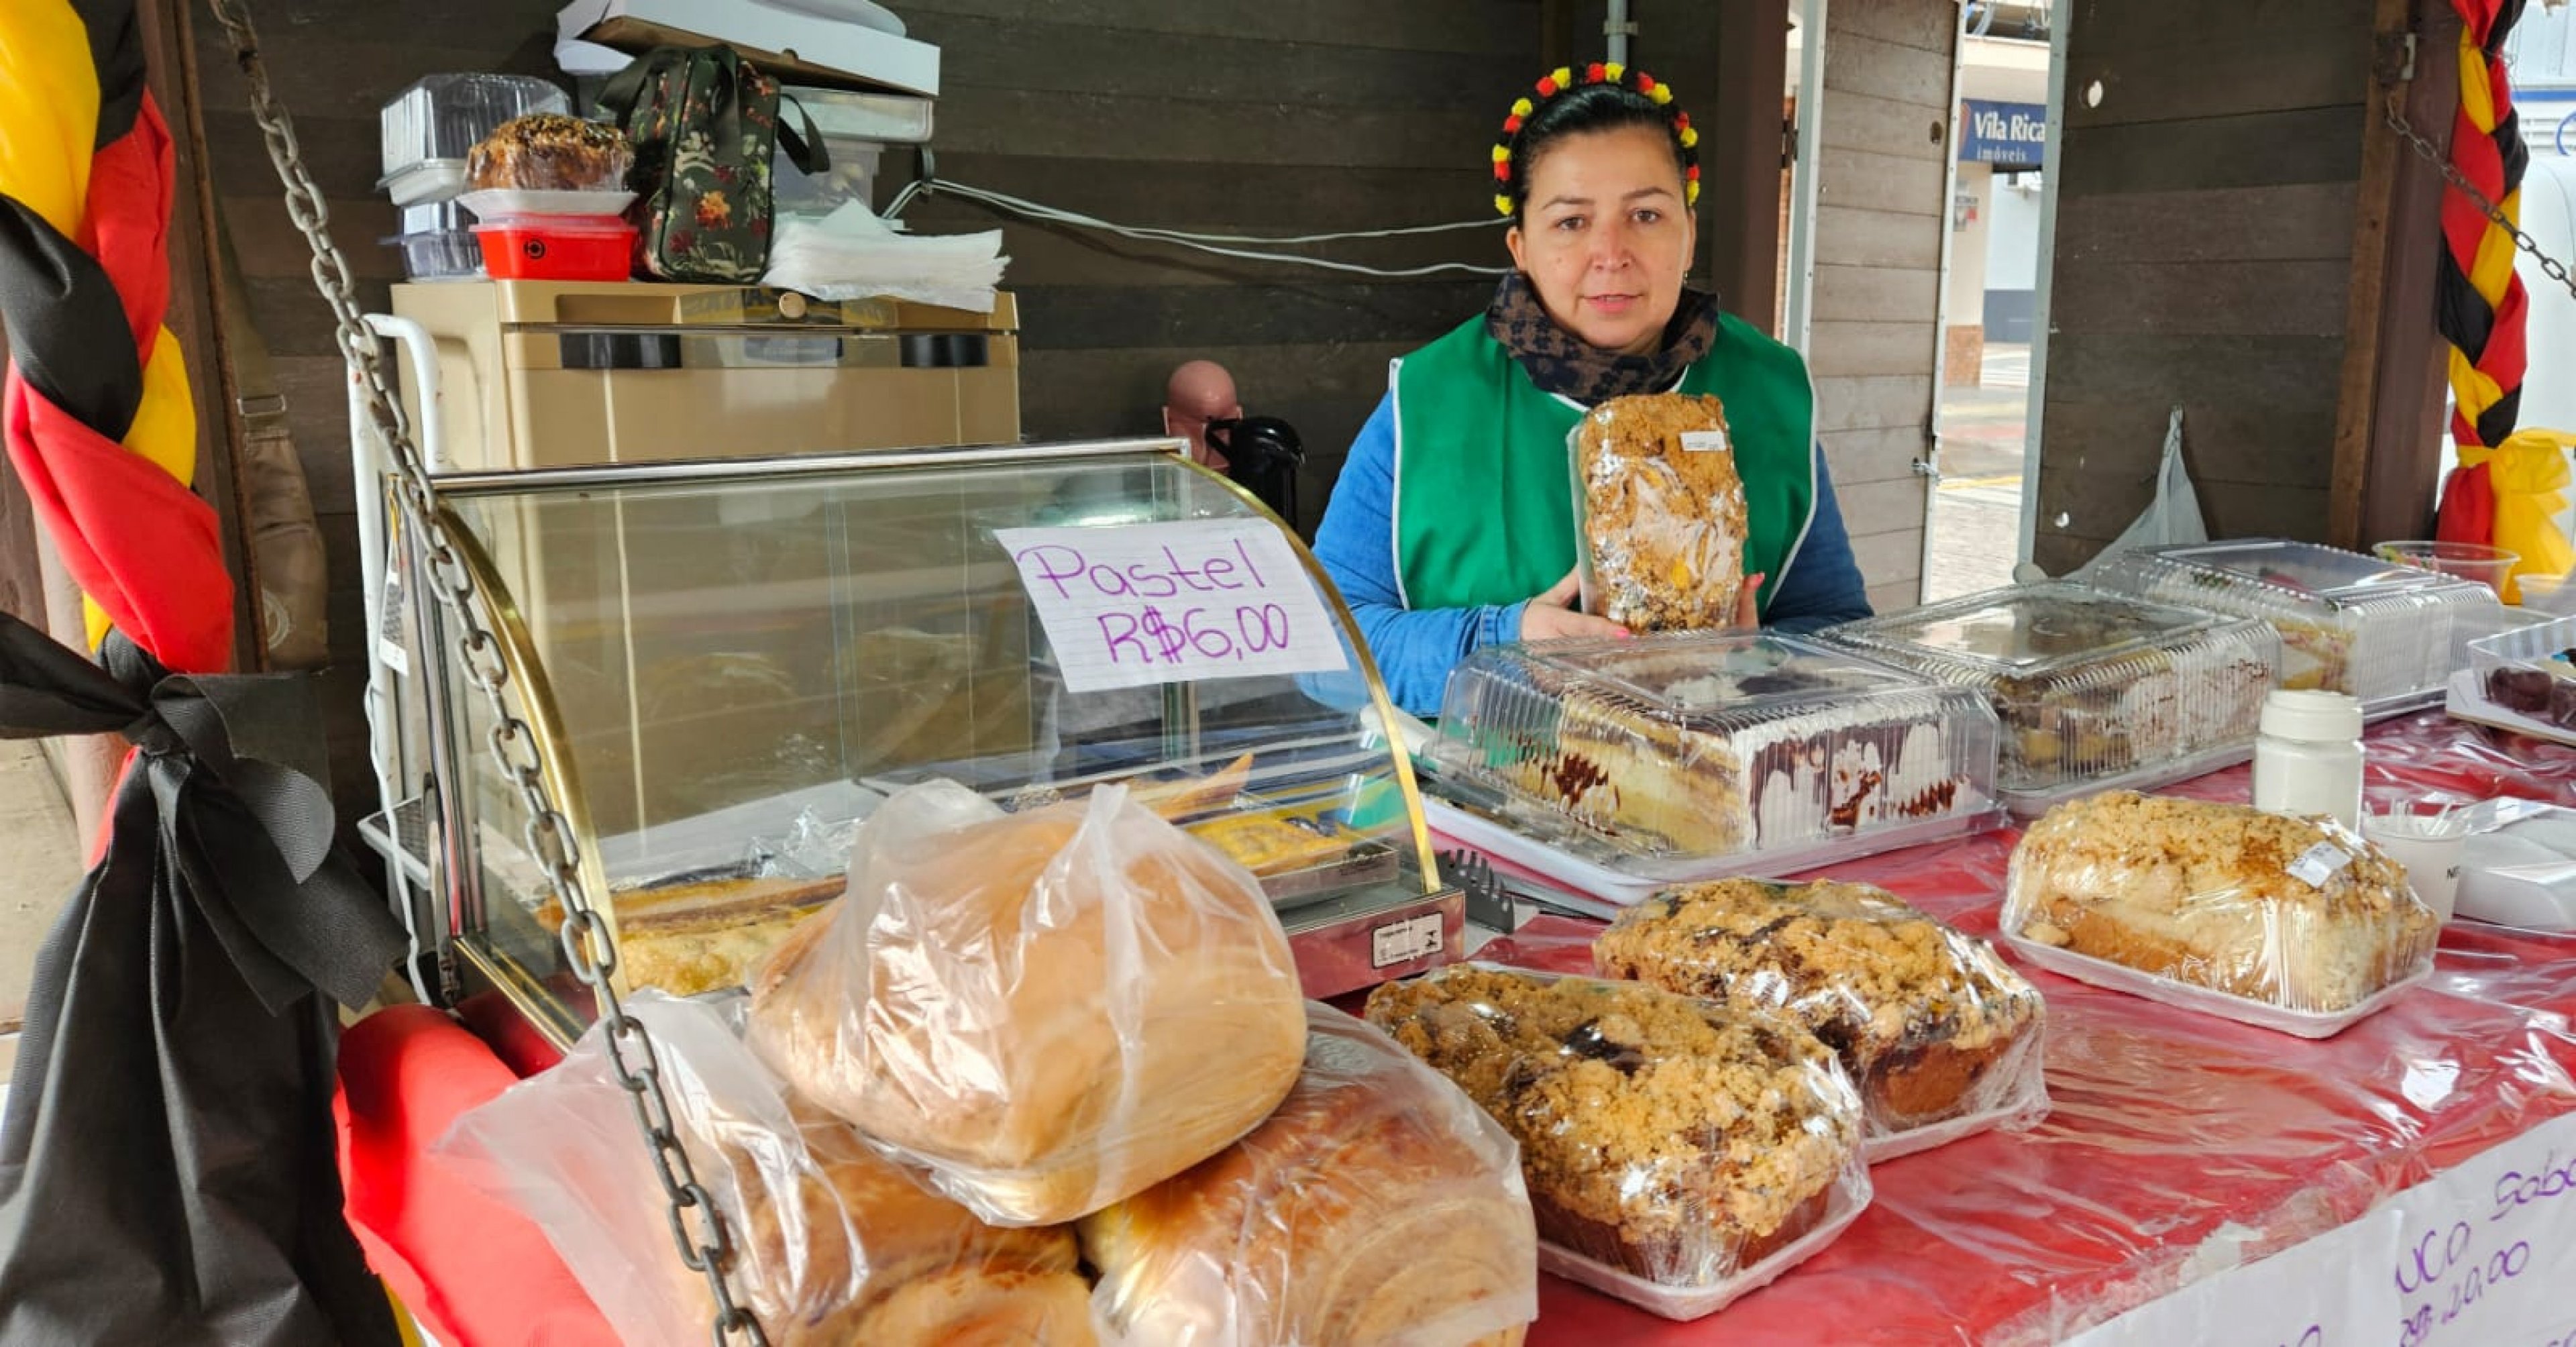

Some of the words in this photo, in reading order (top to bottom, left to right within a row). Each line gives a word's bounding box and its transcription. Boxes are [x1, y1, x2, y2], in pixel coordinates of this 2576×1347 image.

[1975, 111, 2007, 140] Vila
[2011, 113, 2045, 142] Rica
[1016, 539, 1265, 599] Pastel
[1097, 604, 1289, 663] R$6,00
